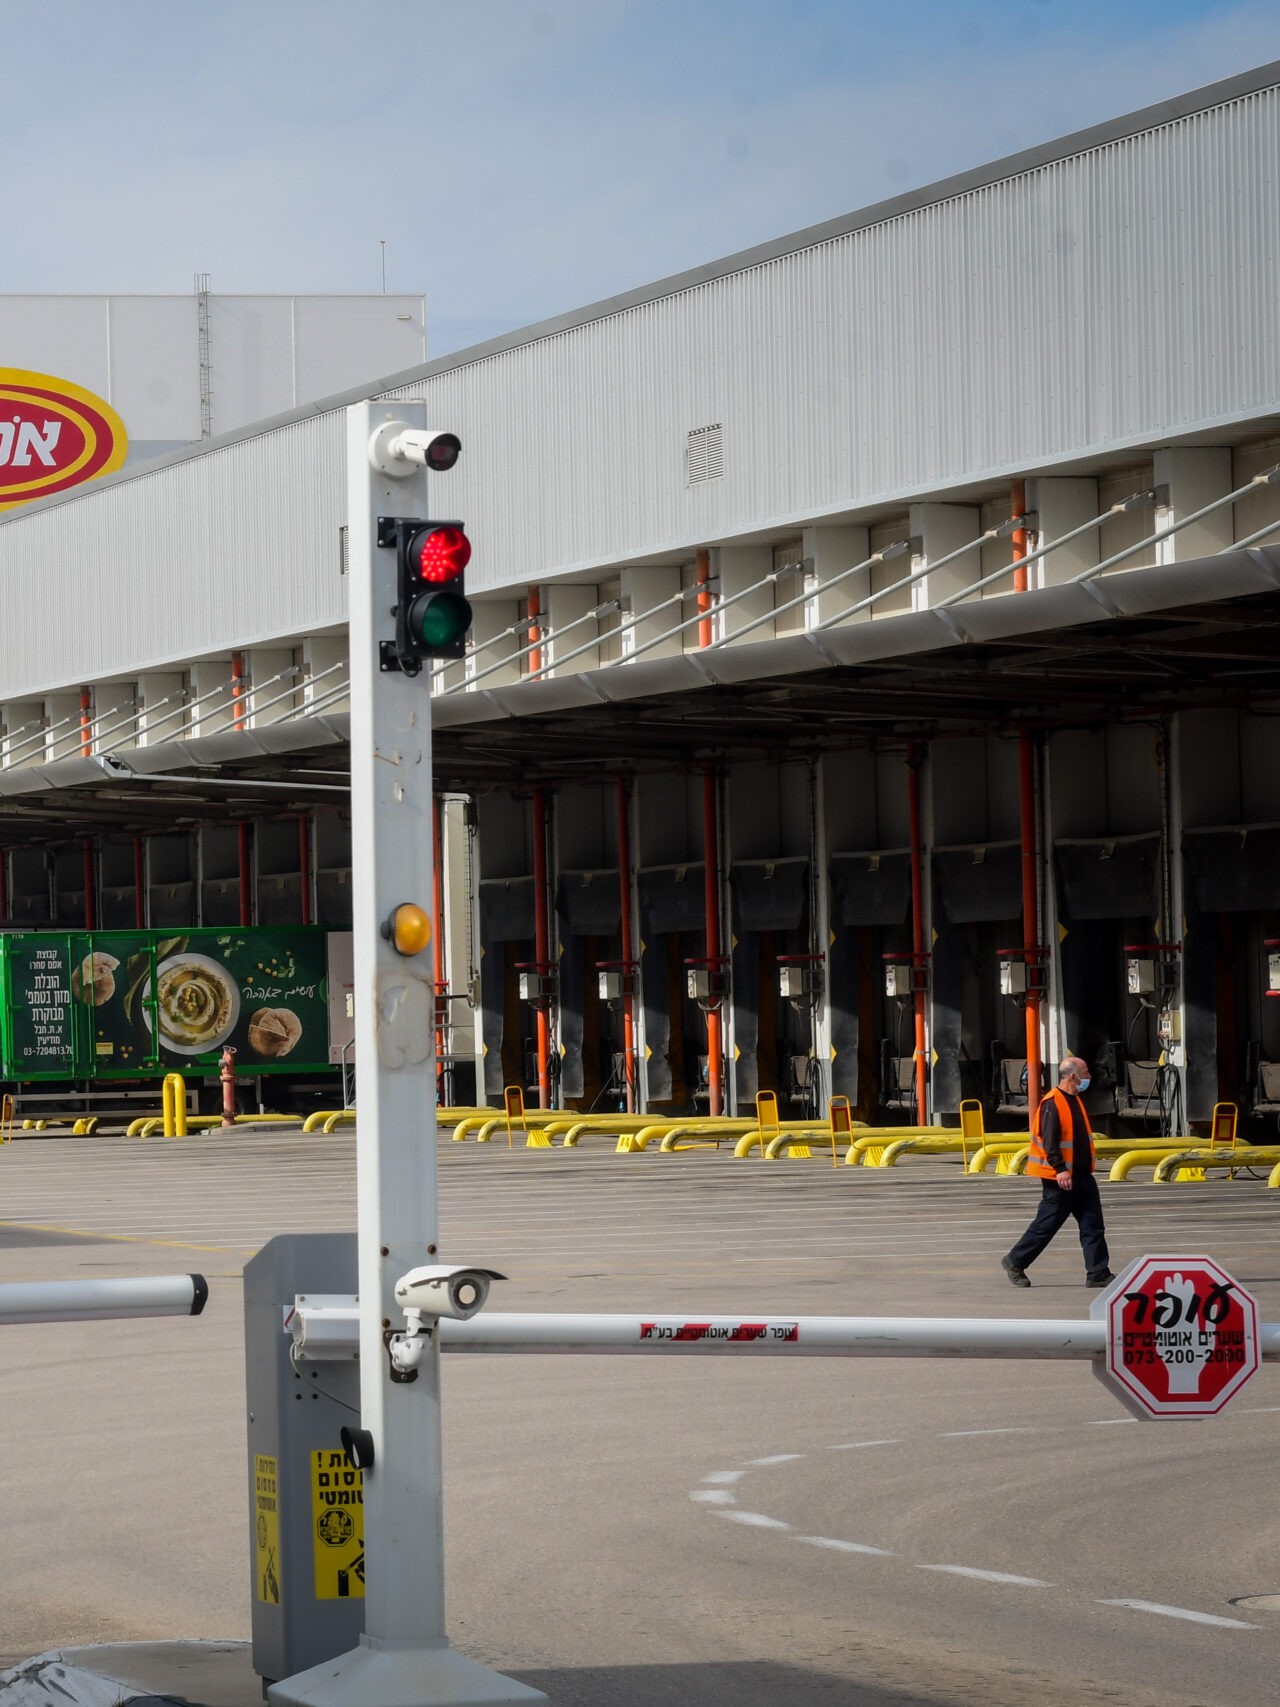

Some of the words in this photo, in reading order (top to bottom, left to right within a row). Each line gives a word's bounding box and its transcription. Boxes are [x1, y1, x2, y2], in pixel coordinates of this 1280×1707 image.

[36, 950, 58, 960] קבוצת
[47, 961, 62, 969] אסם
[34, 972, 60, 989] הובלת
[53, 990, 70, 1007] מזון
[242, 986, 282, 1001] באהבה
[31, 1007, 64, 1024] מבוקרת
[37, 1035, 61, 1046] מודיעין
[1124, 1283, 1235, 1329] עופר
[676, 1327, 729, 1339] אוטומטיים
[731, 1327, 767, 1339] שערים
[1124, 1331, 1192, 1347] אוטומטיים
[1198, 1330, 1244, 1346] שערים
[1124, 1348, 1245, 1364] 073-200-2000
[318, 1471, 363, 1487] סום
